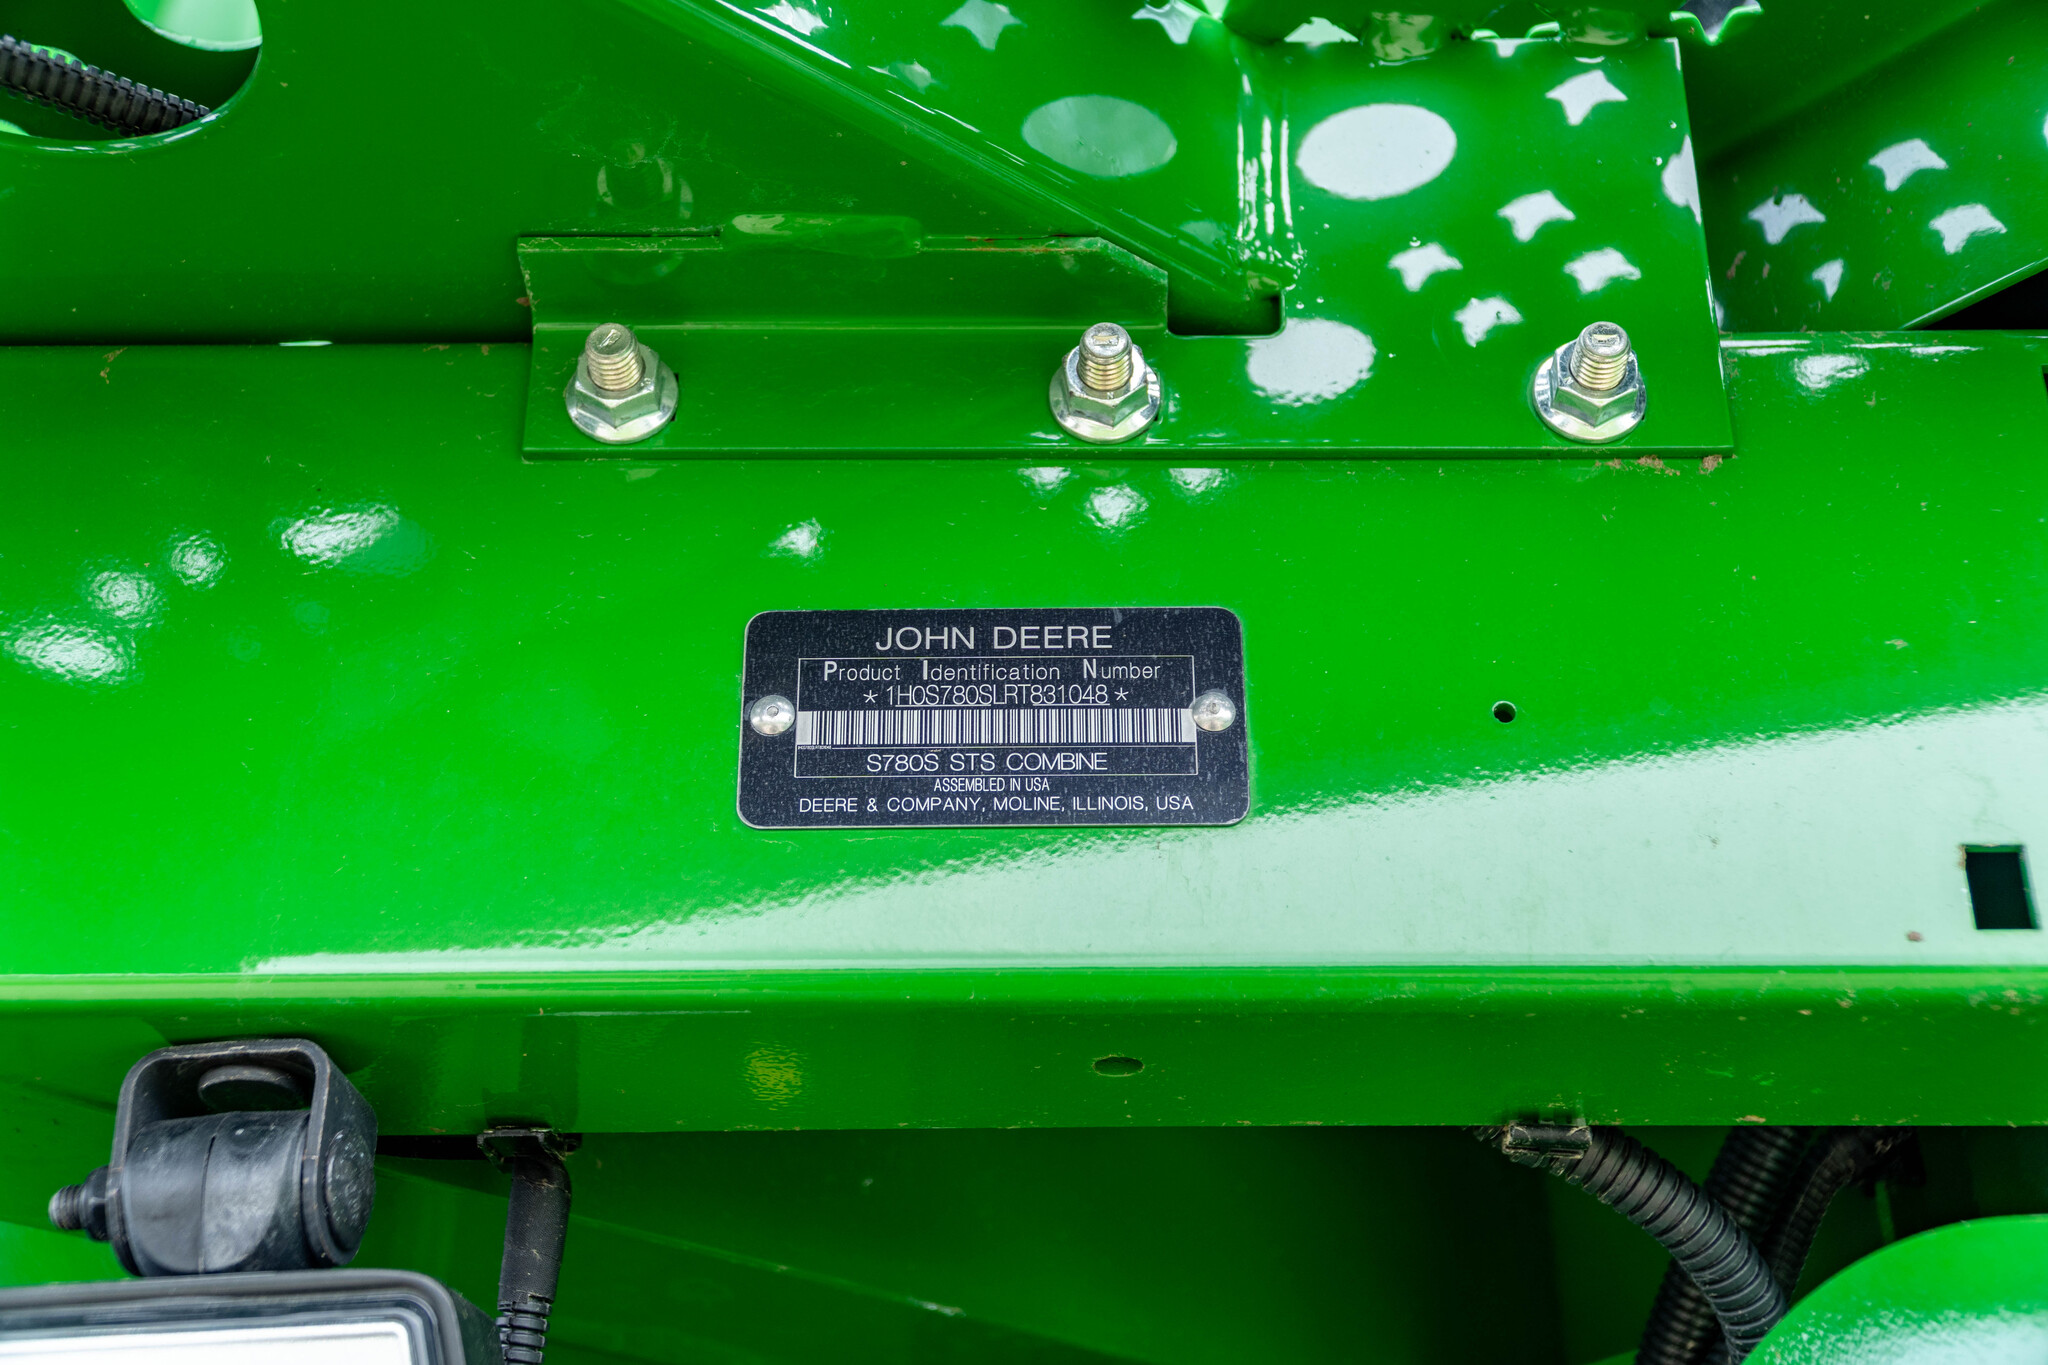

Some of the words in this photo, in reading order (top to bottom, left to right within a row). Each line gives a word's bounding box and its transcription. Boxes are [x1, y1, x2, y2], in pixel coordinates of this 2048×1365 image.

[875, 626, 975, 651] JOHN
[993, 625, 1113, 649] DEERE
[823, 660, 901, 682] Product
[922, 659, 1060, 681] Identification
[1082, 658, 1161, 680] Number
[886, 684, 1109, 706] 1H0S780SLRT831048
[866, 753, 939, 772] S780S
[949, 753, 996, 771] STS
[1006, 752, 1108, 771] COMBINE
[933, 777, 1006, 793] ASSEMBLED
[1009, 777, 1022, 792] IN
[1025, 777, 1050, 792] USA
[799, 797, 858, 813] DEERE
[866, 797, 878, 812] &
[886, 796, 986, 813] COMPANY,
[993, 795, 1066, 812] MOLINE,
[1072, 795, 1149, 812] ILLINOIS,
[1156, 795, 1194, 811] USA
